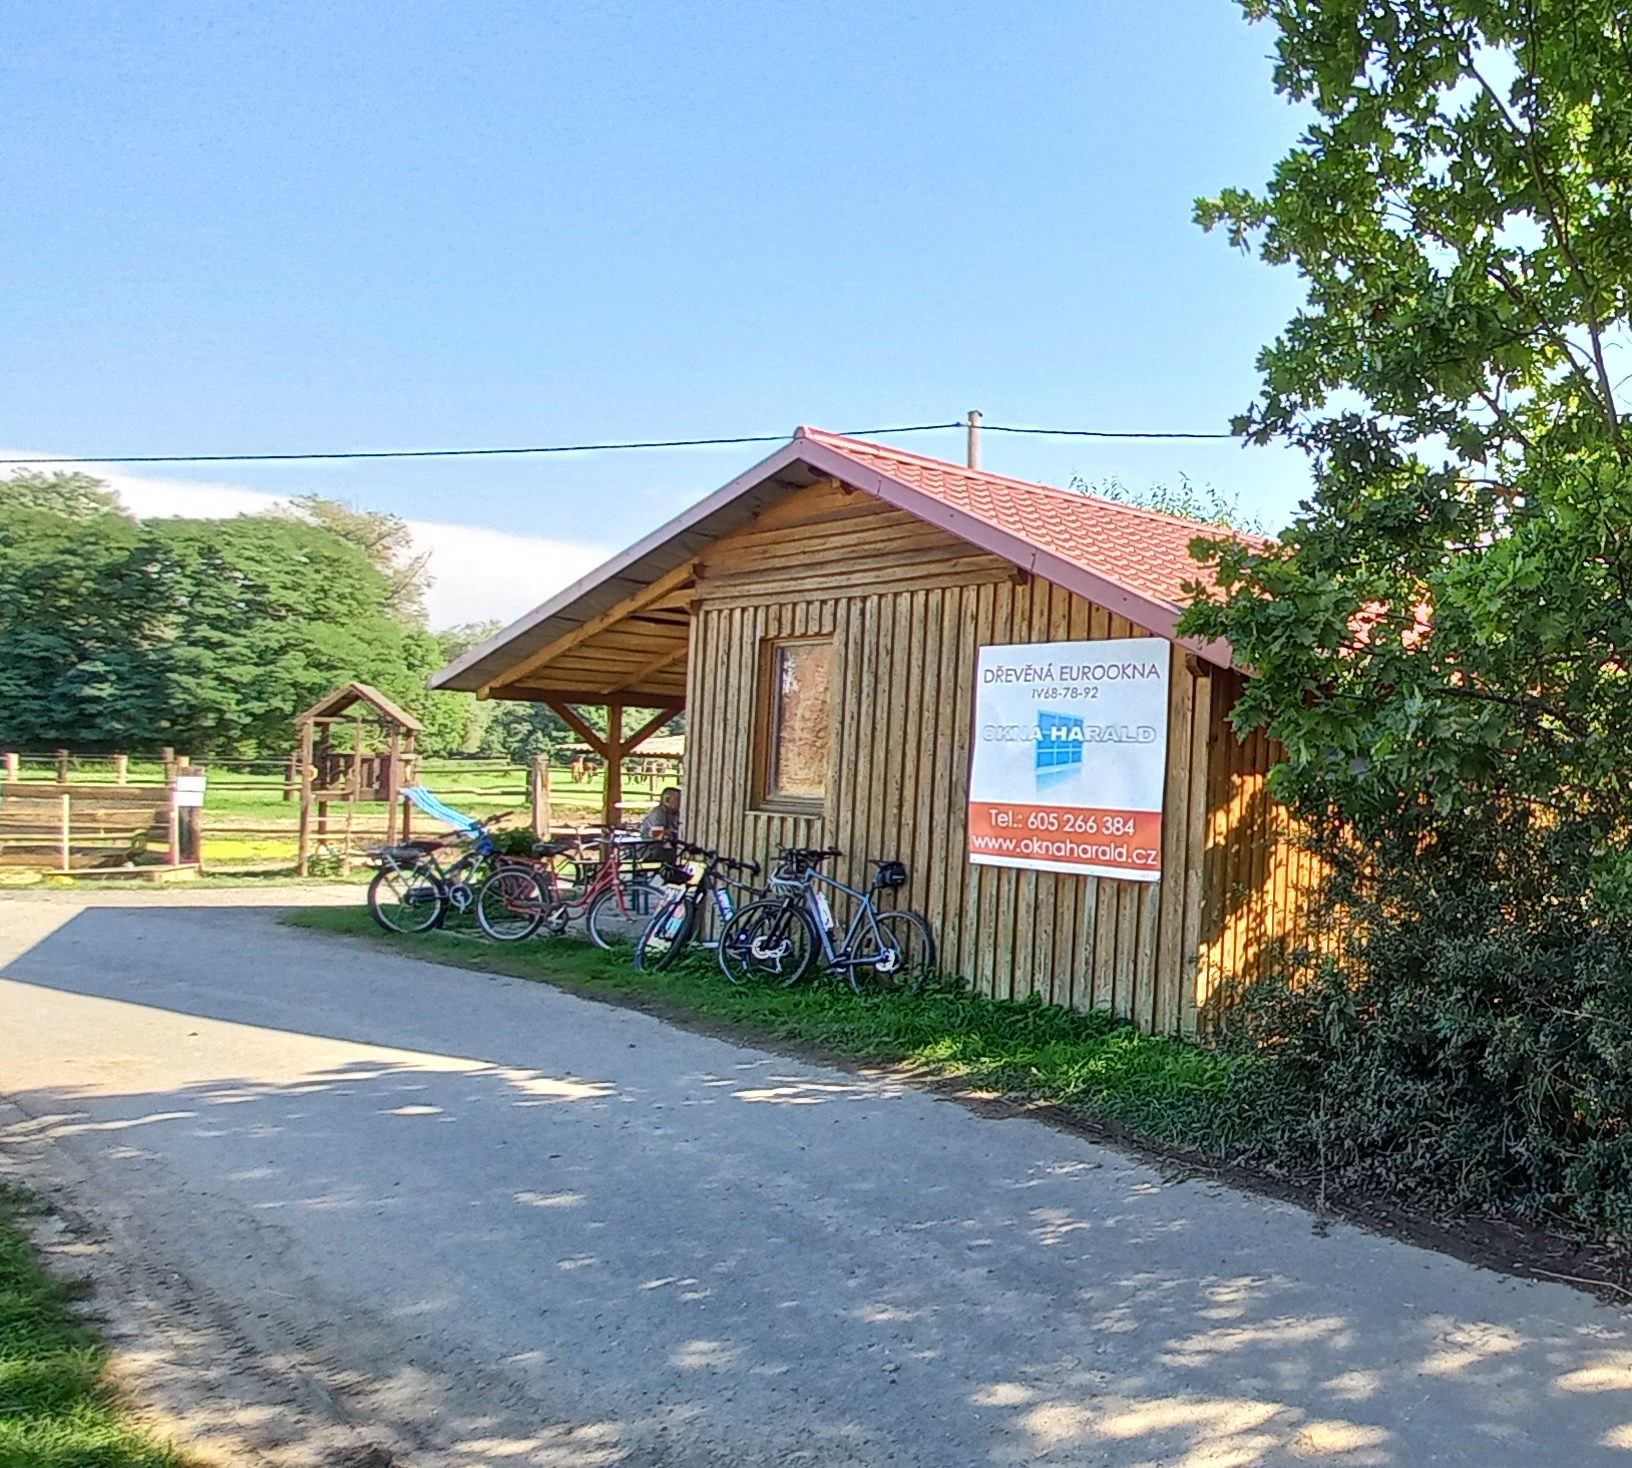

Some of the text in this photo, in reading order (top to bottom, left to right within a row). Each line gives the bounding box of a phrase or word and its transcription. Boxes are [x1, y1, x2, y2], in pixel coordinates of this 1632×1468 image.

[984, 662, 1161, 684] DŘEVĚNÁ EUROOKNA
[1031, 686, 1099, 699] IV68-78-92
[982, 725, 1157, 743] OKNA HARALD
[989, 809, 1135, 836] Tel.: 605 266 384
[972, 834, 1158, 865] www.oknaharald.cz
